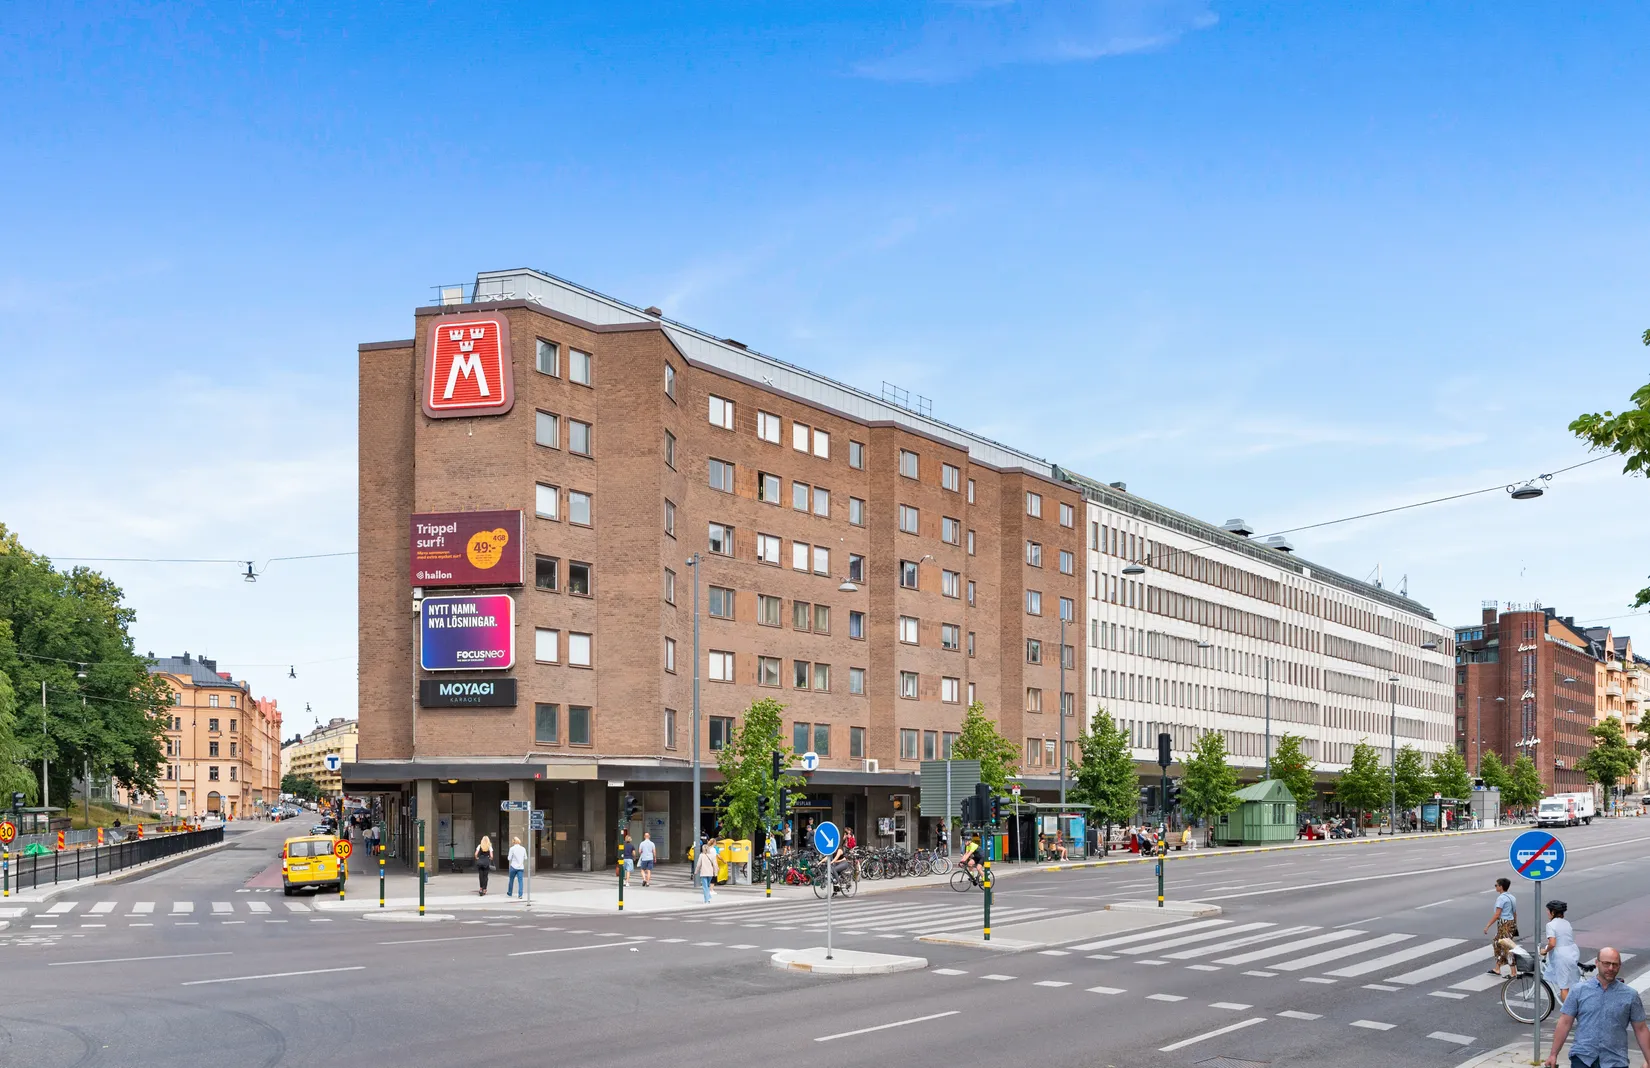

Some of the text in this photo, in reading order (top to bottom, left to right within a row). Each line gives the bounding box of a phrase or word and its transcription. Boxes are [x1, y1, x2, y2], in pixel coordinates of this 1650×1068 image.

[443, 353, 490, 399] M
[416, 522, 457, 536] Trippel
[416, 537, 445, 548] surf!
[473, 541, 496, 553] 49:-
[424, 570, 452, 580] hallon
[428, 603, 478, 616] NYTT NAMN.
[428, 615, 498, 629] NYA LÖSNINGAR.
[1517, 643, 1538, 652] bara
[439, 682, 494, 696] MOYAGI
[327, 757, 339, 769] T
[805, 756, 816, 768] T
[1, 826, 13, 838] 30
[337, 844, 350, 855] 30
